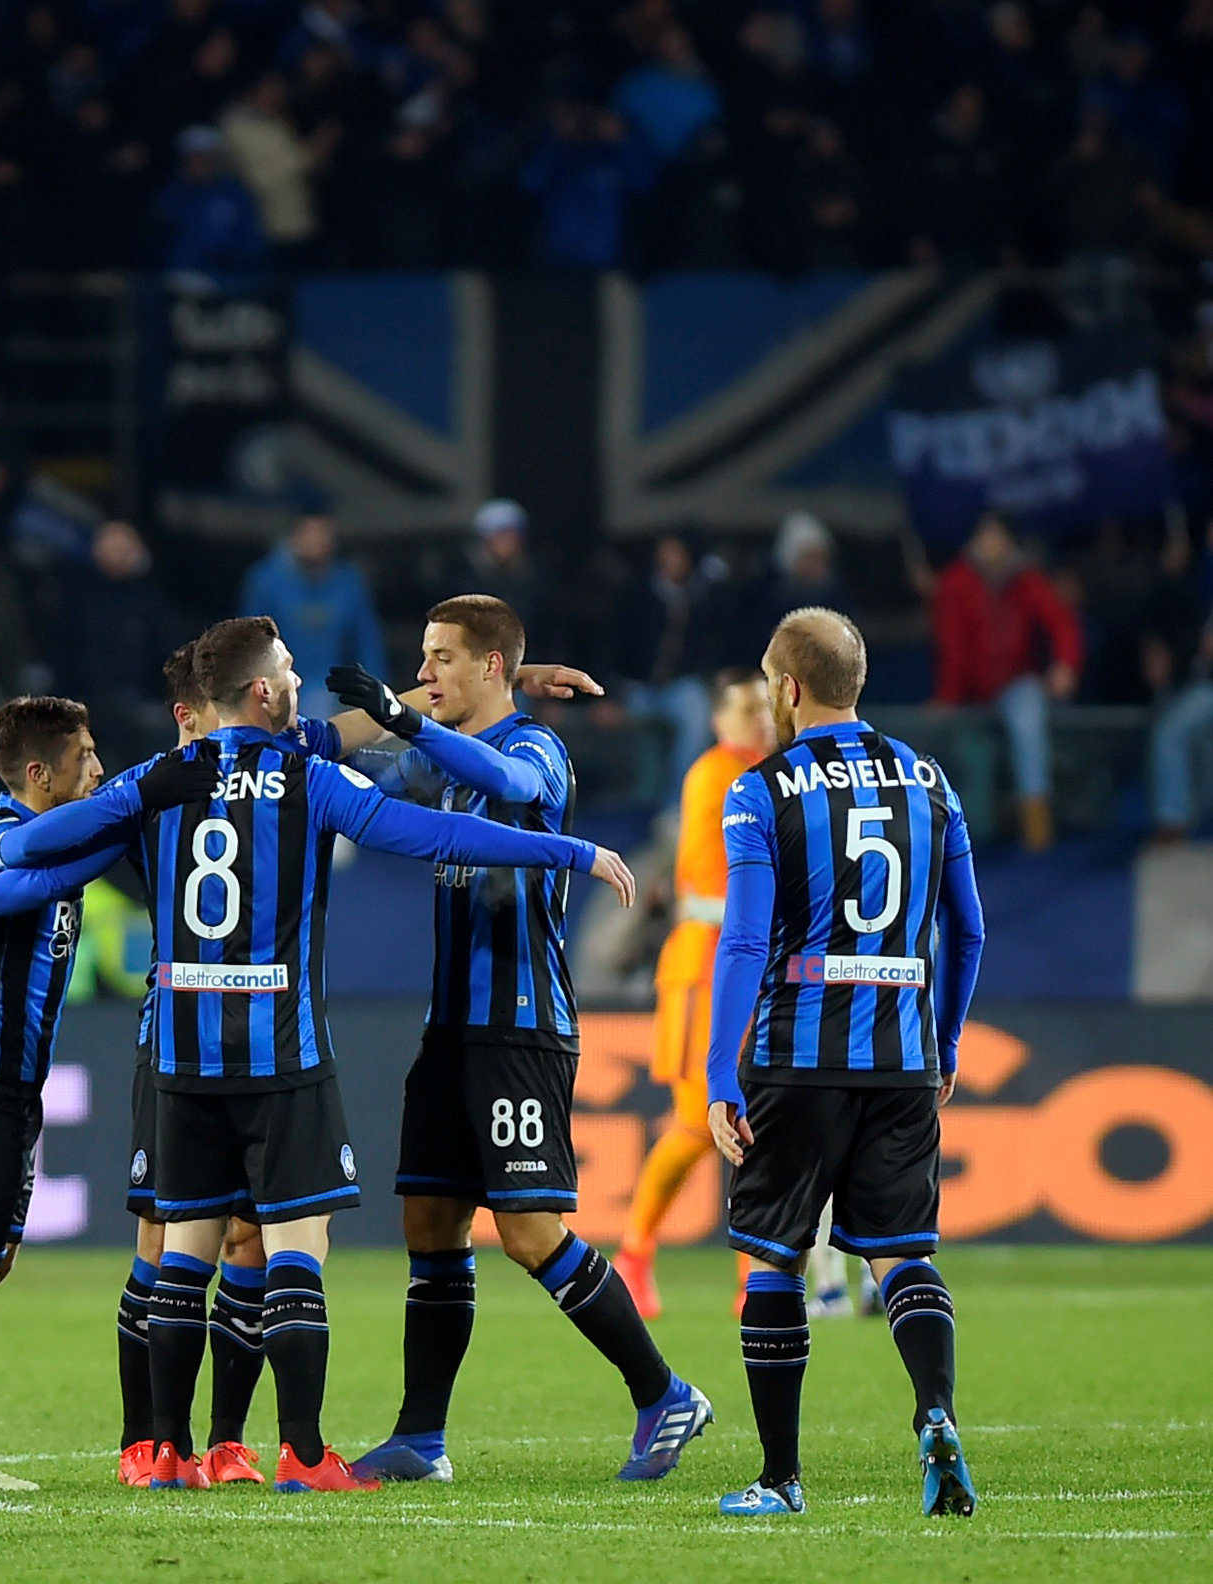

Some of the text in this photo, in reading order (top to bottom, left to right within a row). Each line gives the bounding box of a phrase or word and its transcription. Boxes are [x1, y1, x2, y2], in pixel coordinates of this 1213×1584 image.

[777, 758, 937, 798] MASIELLO
[183, 818, 241, 940] 8
[844, 806, 902, 933] 5
[174, 966, 285, 987] elettrocanali
[491, 1098, 544, 1148] 88
